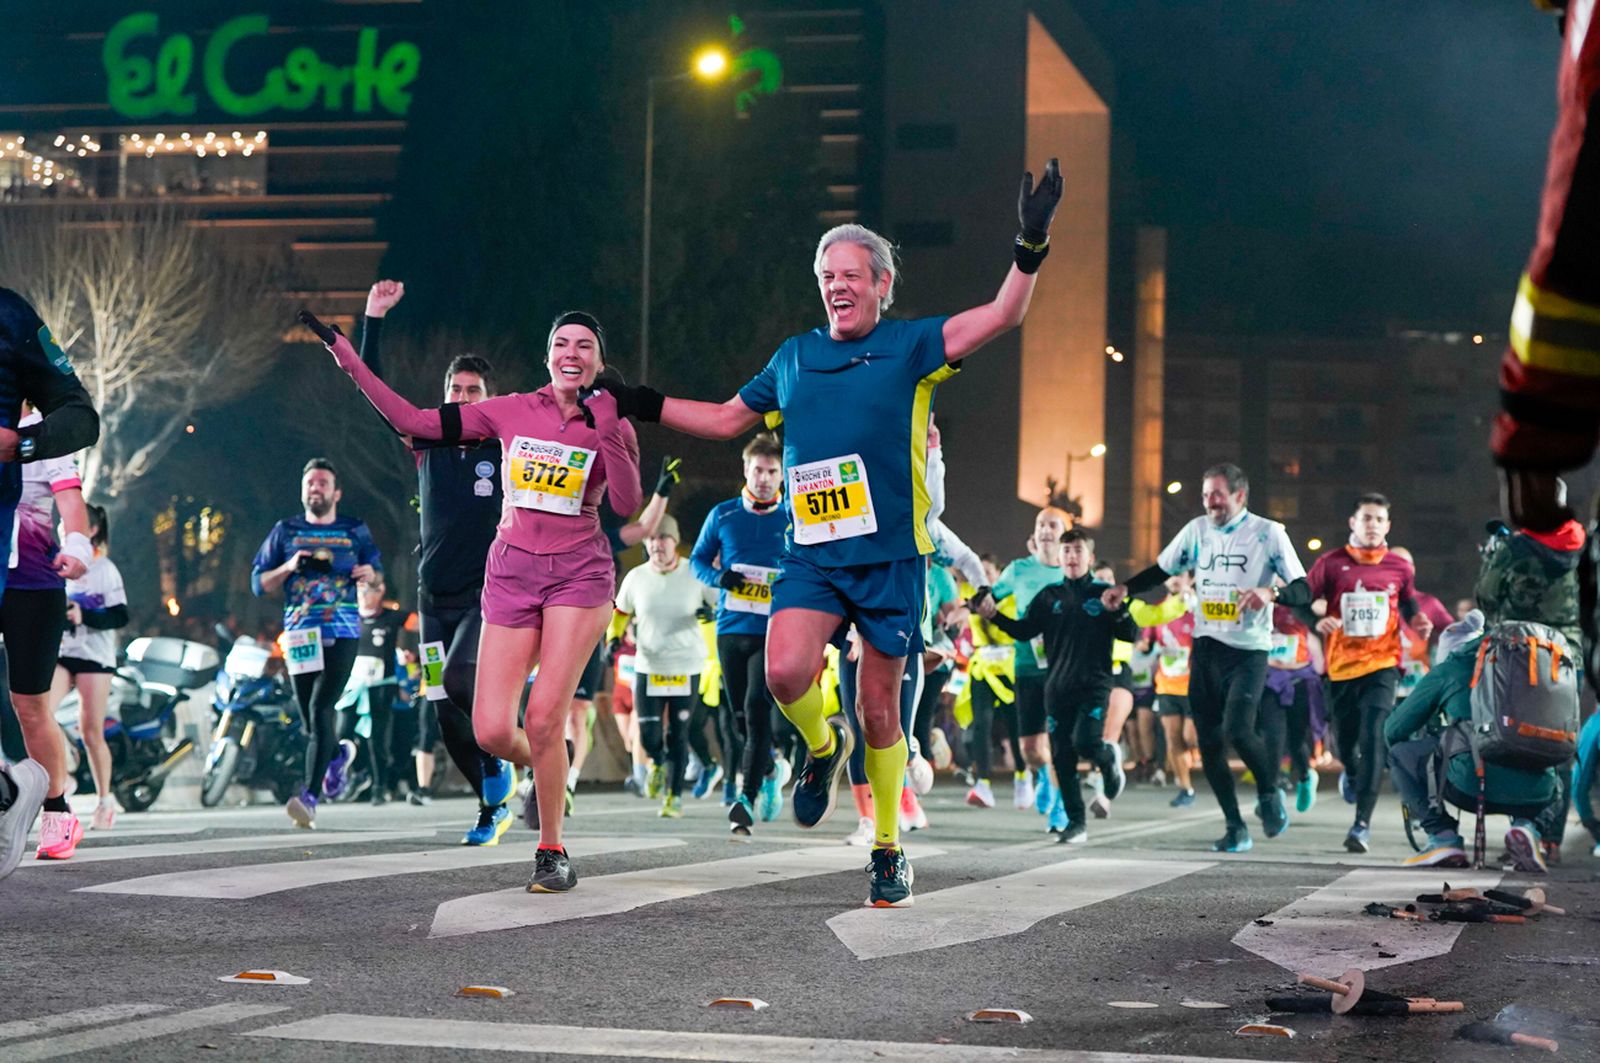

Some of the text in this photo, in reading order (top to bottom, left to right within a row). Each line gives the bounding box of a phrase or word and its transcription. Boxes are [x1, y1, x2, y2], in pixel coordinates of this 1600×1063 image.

[104, 12, 421, 118] El Corte
[517, 450, 533, 459] SAN
[529, 446, 553, 455] NOCHE
[554, 449, 564, 457] DE
[523, 460, 569, 488] 5712
[801, 471, 822, 481] NOCHE
[823, 468, 832, 478] DE
[797, 484, 809, 493] SAN
[806, 487, 850, 515] 5711
